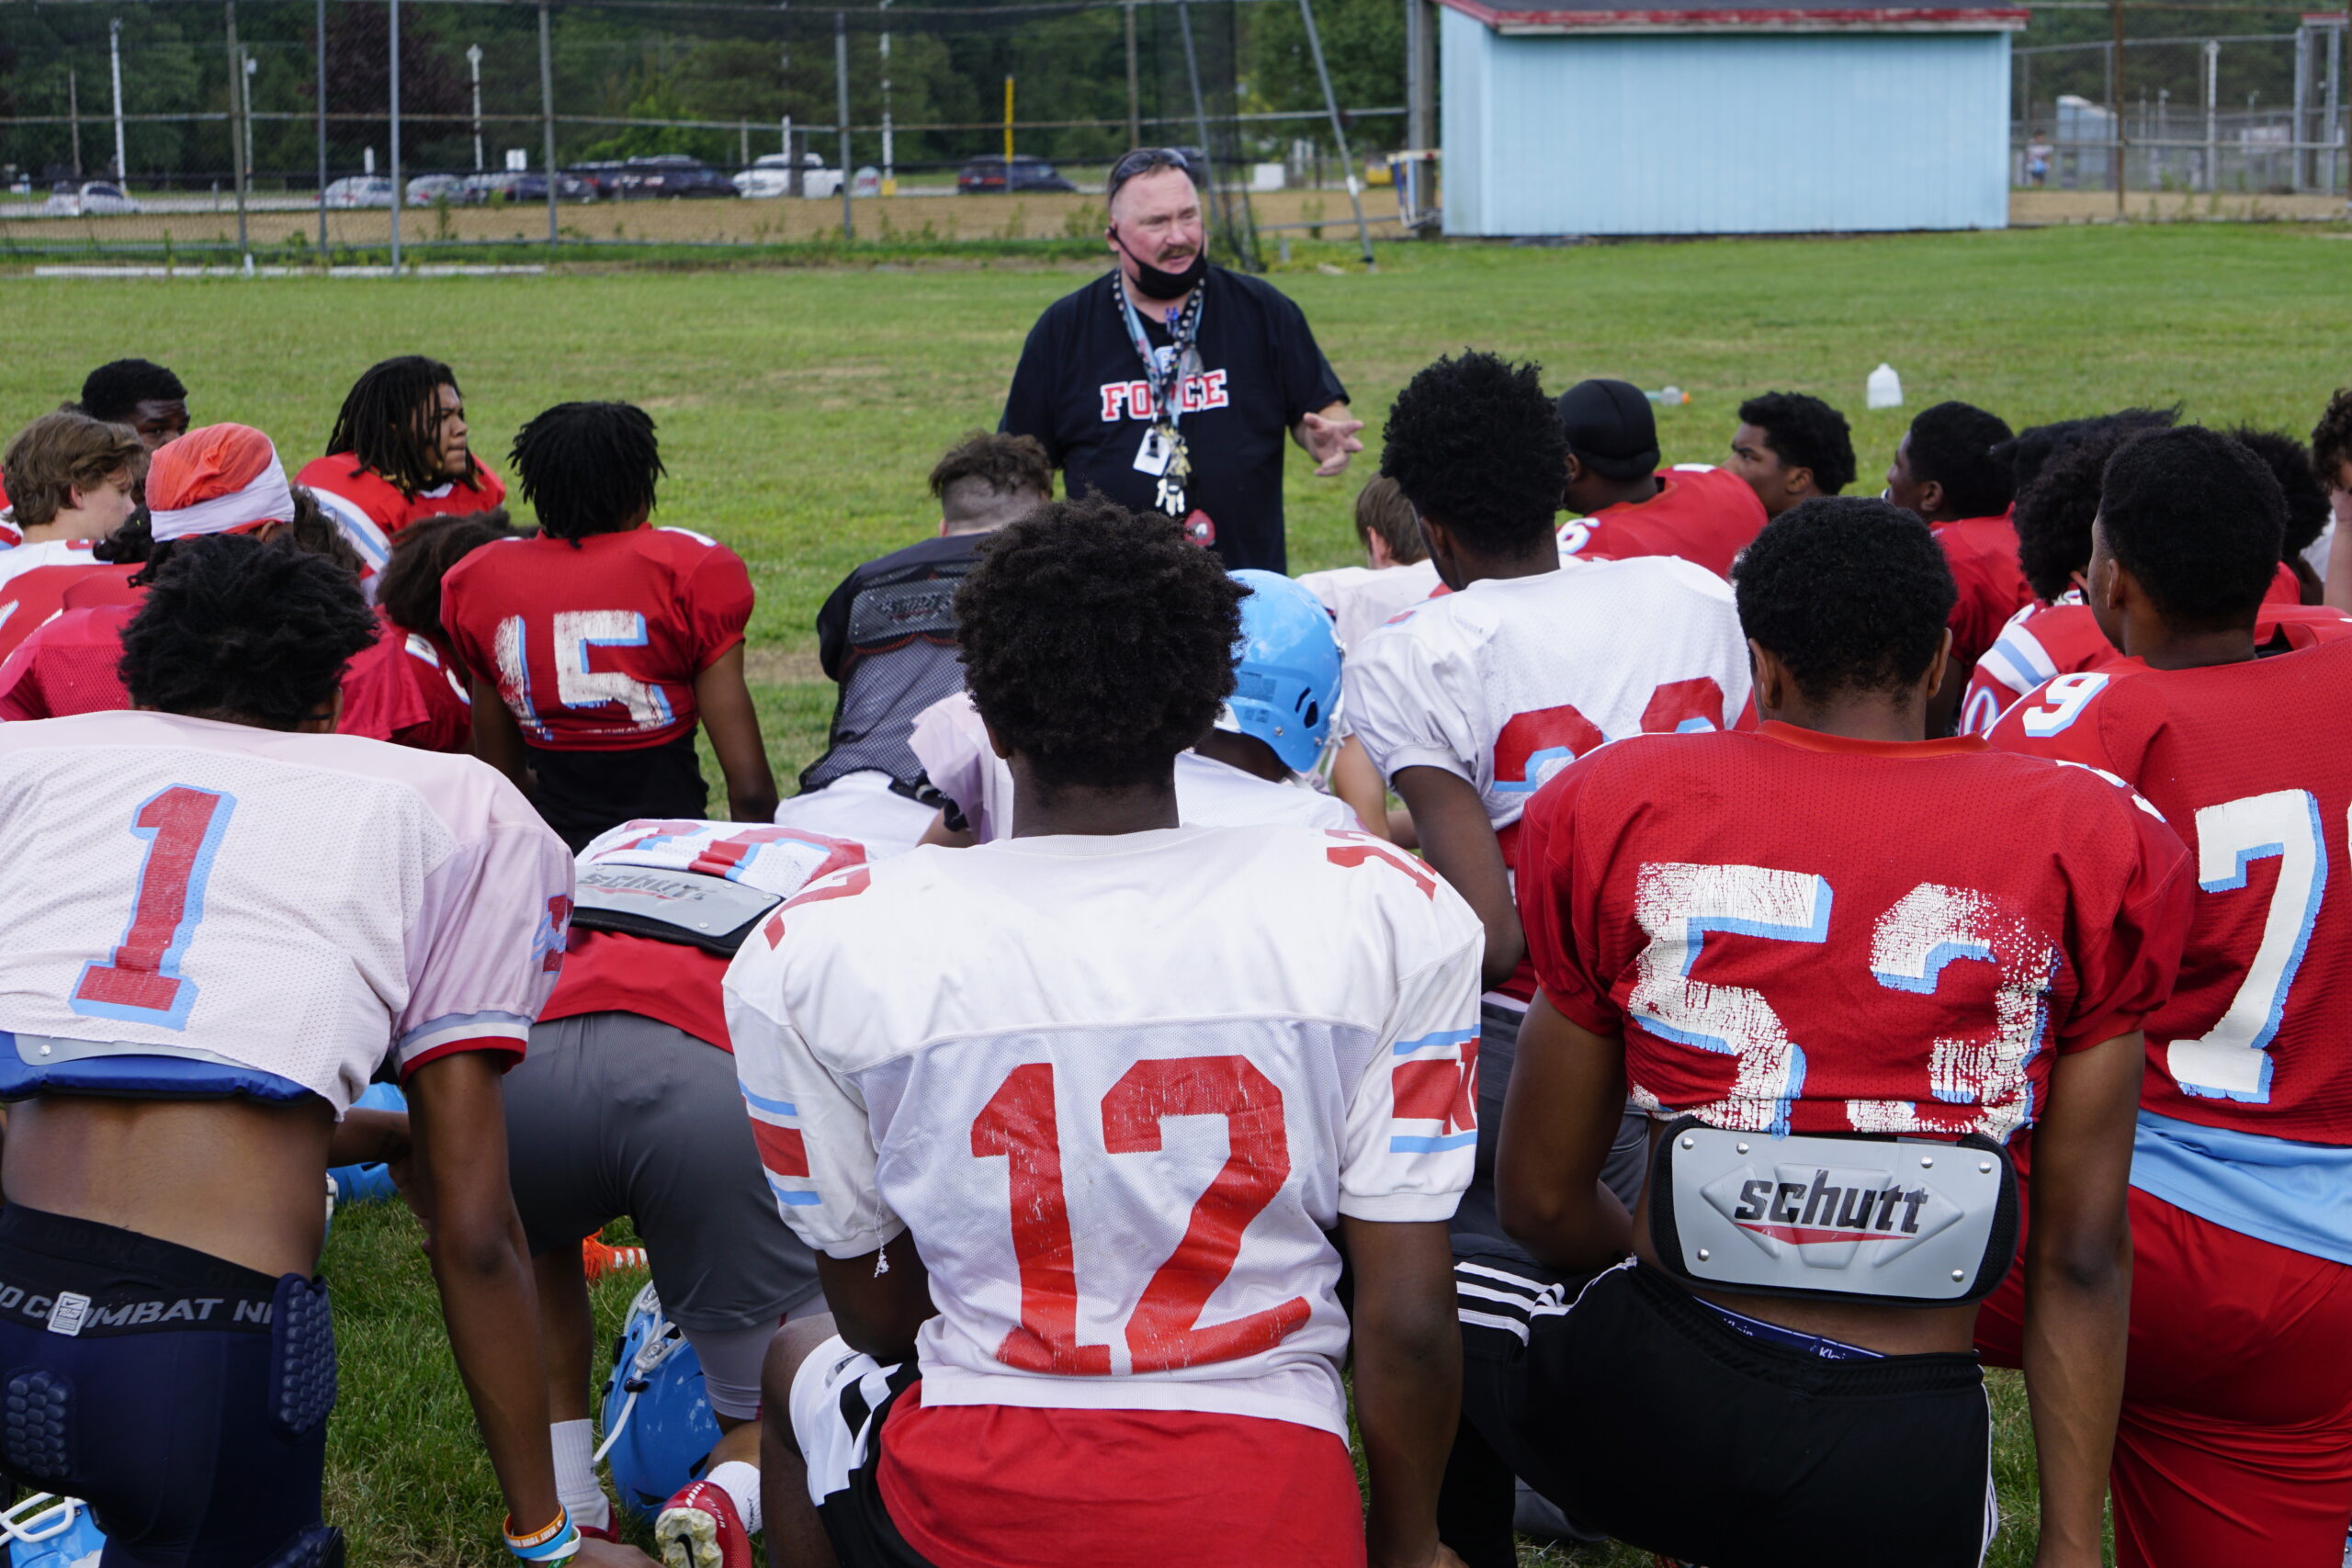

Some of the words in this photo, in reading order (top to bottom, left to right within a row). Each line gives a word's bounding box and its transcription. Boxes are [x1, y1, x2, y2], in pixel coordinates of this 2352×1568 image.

[494, 610, 676, 740] 15
[69, 783, 237, 1031] 1
[1628, 862, 2062, 1146] 53
[2166, 788, 2352, 1103] 7
[970, 1055, 1311, 1374] 12
[1735, 1168, 1928, 1234] schutt
